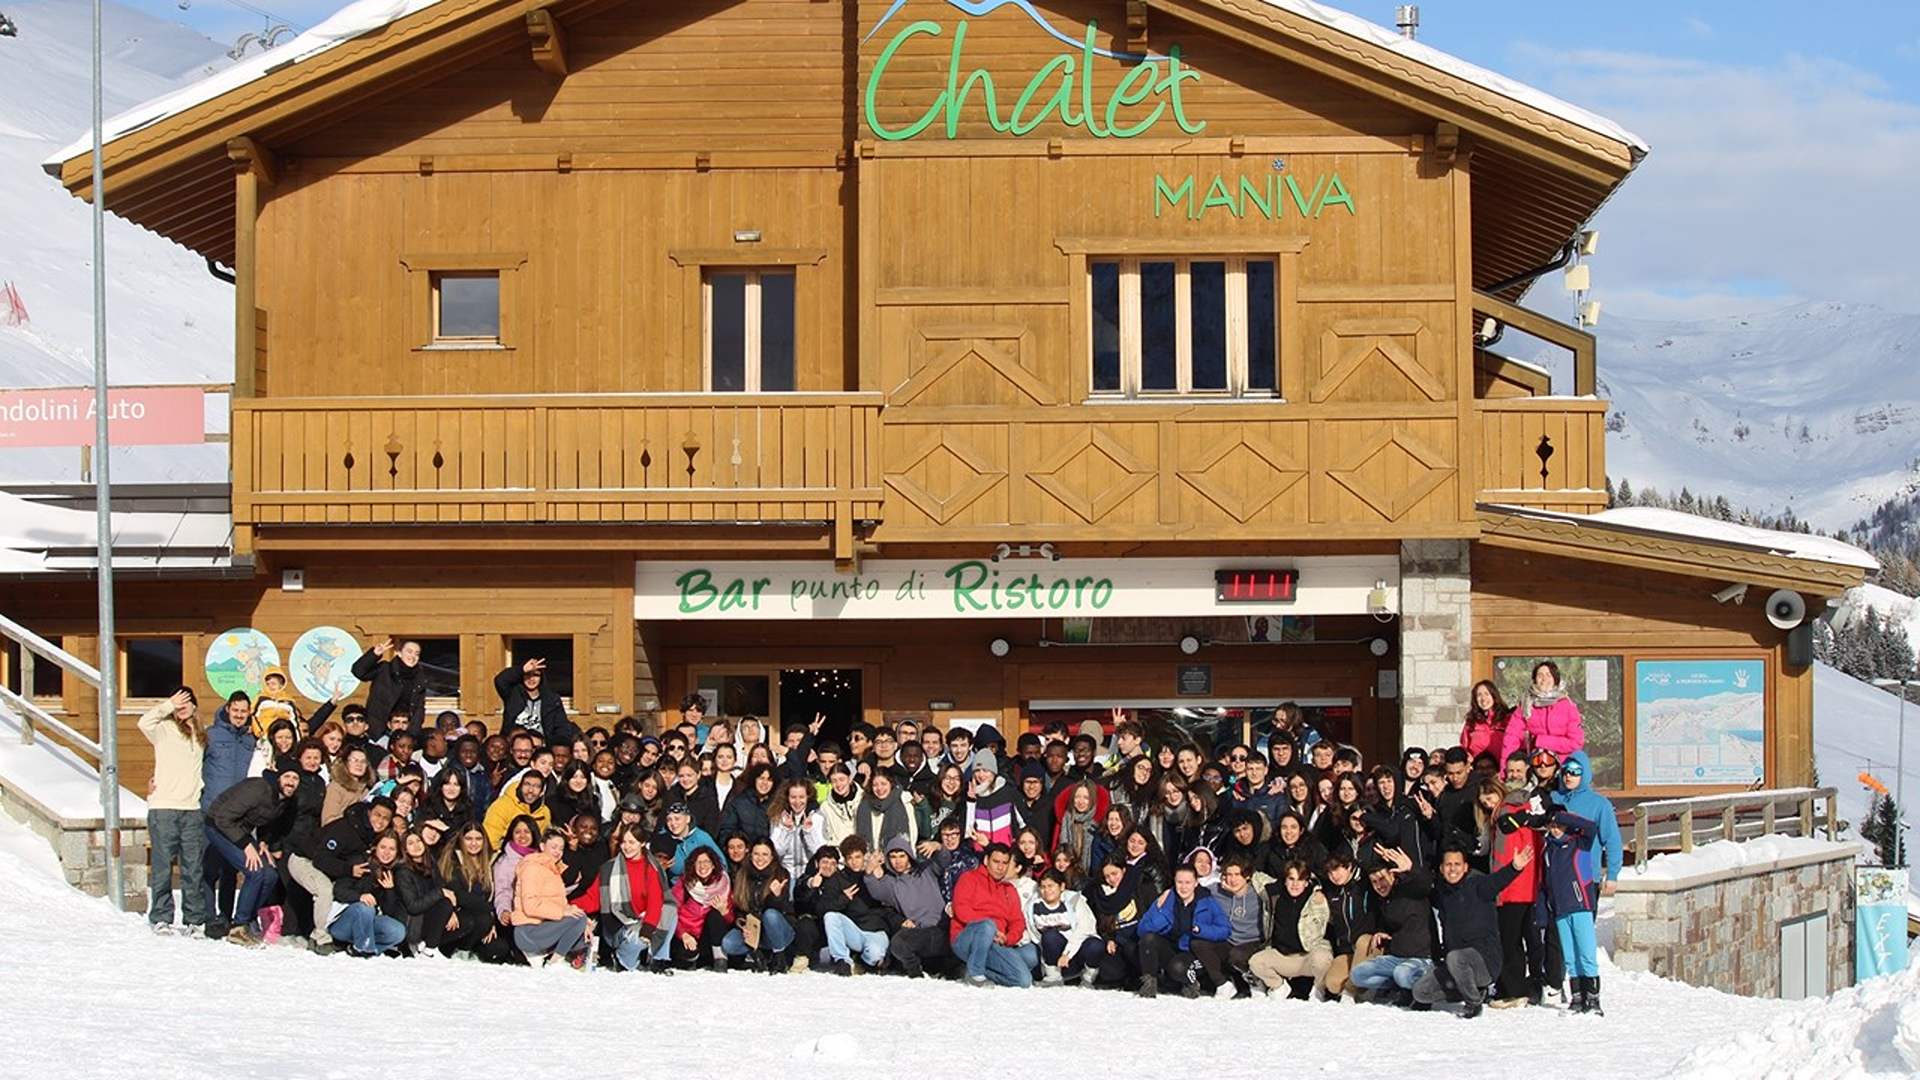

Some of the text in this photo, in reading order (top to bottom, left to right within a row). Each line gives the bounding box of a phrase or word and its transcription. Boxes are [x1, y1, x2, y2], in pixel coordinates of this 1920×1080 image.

[865, 19, 1206, 140] Chalet
[1155, 173, 1356, 220] MANIVA
[86, 398, 145, 420] Auto
[675, 561, 1113, 613] Bar punto di Ristoro
